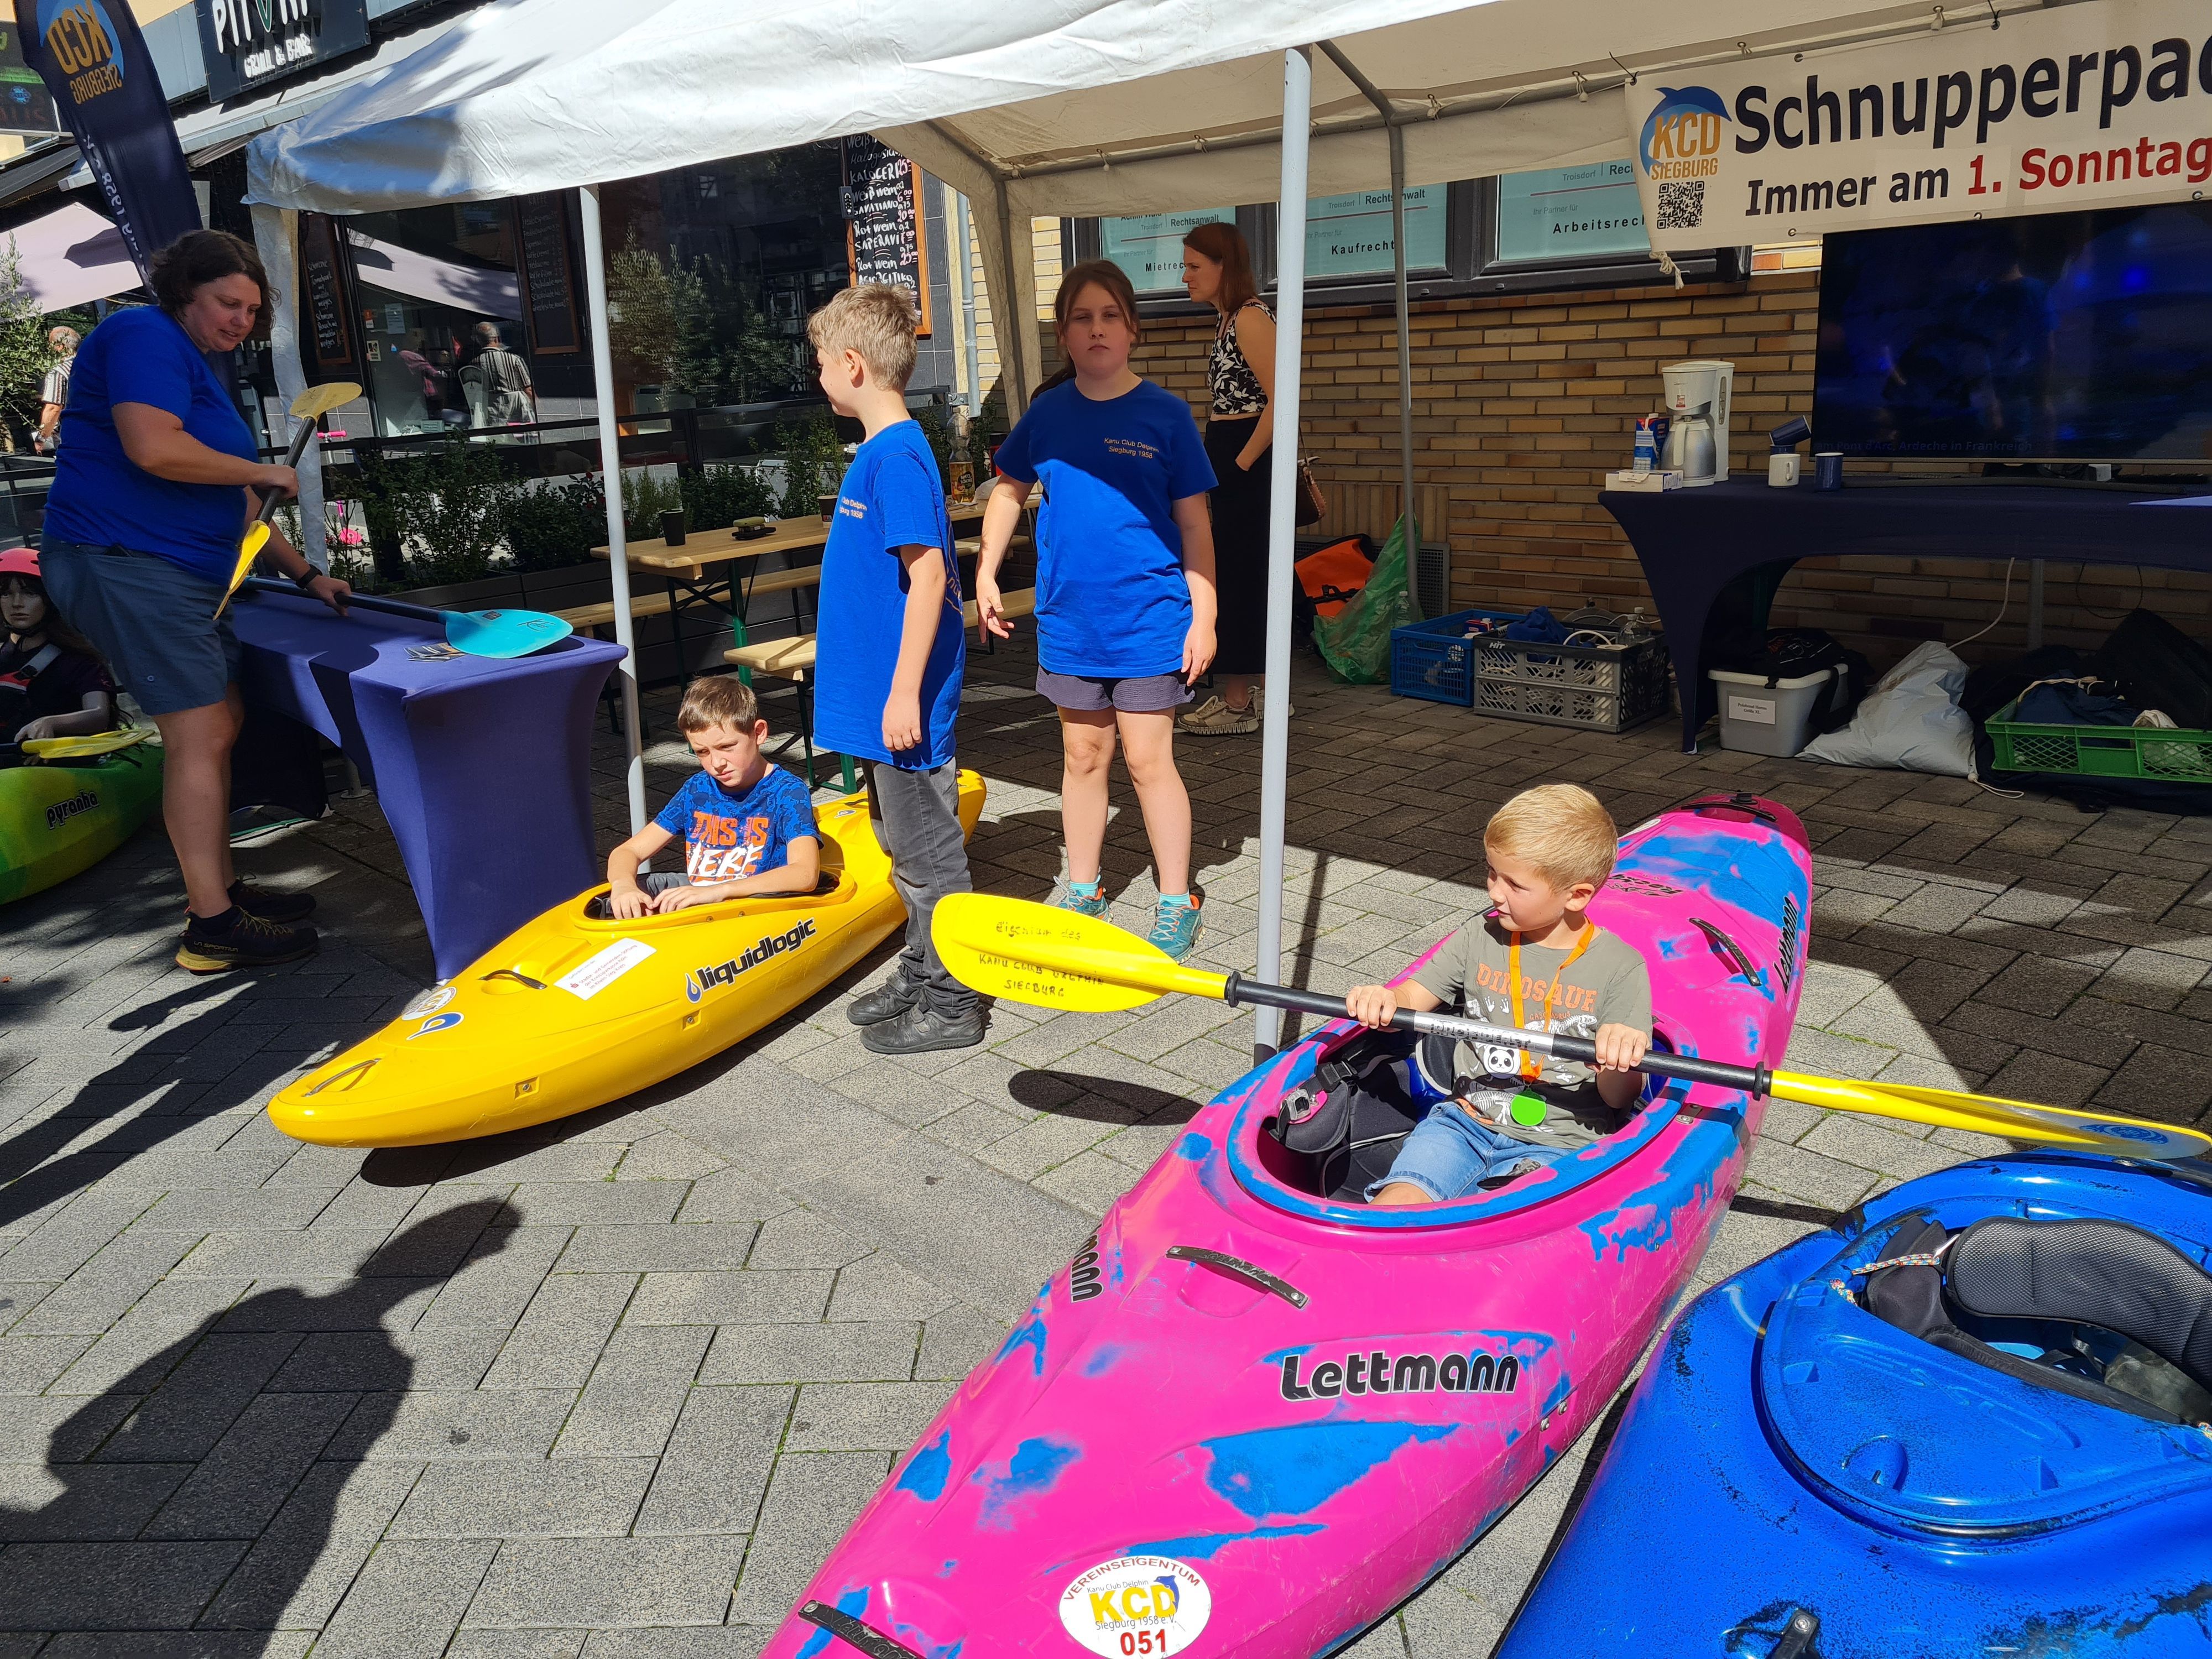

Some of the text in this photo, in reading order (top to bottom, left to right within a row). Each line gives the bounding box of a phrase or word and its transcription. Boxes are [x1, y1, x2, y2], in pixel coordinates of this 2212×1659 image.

[244, 33, 314, 78] GRILL & BAR
[1652, 112, 1721, 160] KCD
[1562, 170, 1597, 181] Troisdorf
[1651, 157, 1719, 180] SIEGBURG
[1745, 135, 2212, 216] Immer am 1. Sonntag
[1328, 199, 1355, 209] Troisdorf
[1543, 205, 1567, 215] Partner
[1171, 213, 1220, 227] Rechtsanwalt
[1332, 239, 1395, 255] Kaufrecht
[1109, 446, 1153, 459] Siegburg 1958
[1898, 441, 1948, 451] Ardeche
[1950, 441, 1961, 451] in
[1966, 441, 2032, 451] Frankreich
[851, 509, 863, 519] 1958
[46, 789, 100, 830] pyranha
[691, 811, 738, 846] THIS
[696, 919, 817, 991] liquidlogic
[1773, 896, 1799, 994] Lettmann
[979, 953, 1008, 968] KANU
[1013, 961, 1042, 975] CLUB
[1280, 1350, 1520, 1403] Lettmann
[1063, 1556, 1200, 1601] VEREINSEIGENTUM
[1087, 1579, 1149, 1593] Kanu Club Delphin
[1089, 1584, 1177, 1625] KCD
[1095, 1618, 1136, 1631] Siegburg
[1138, 1615, 1159, 1626] 1958
[1120, 1629, 1166, 1656] 051
